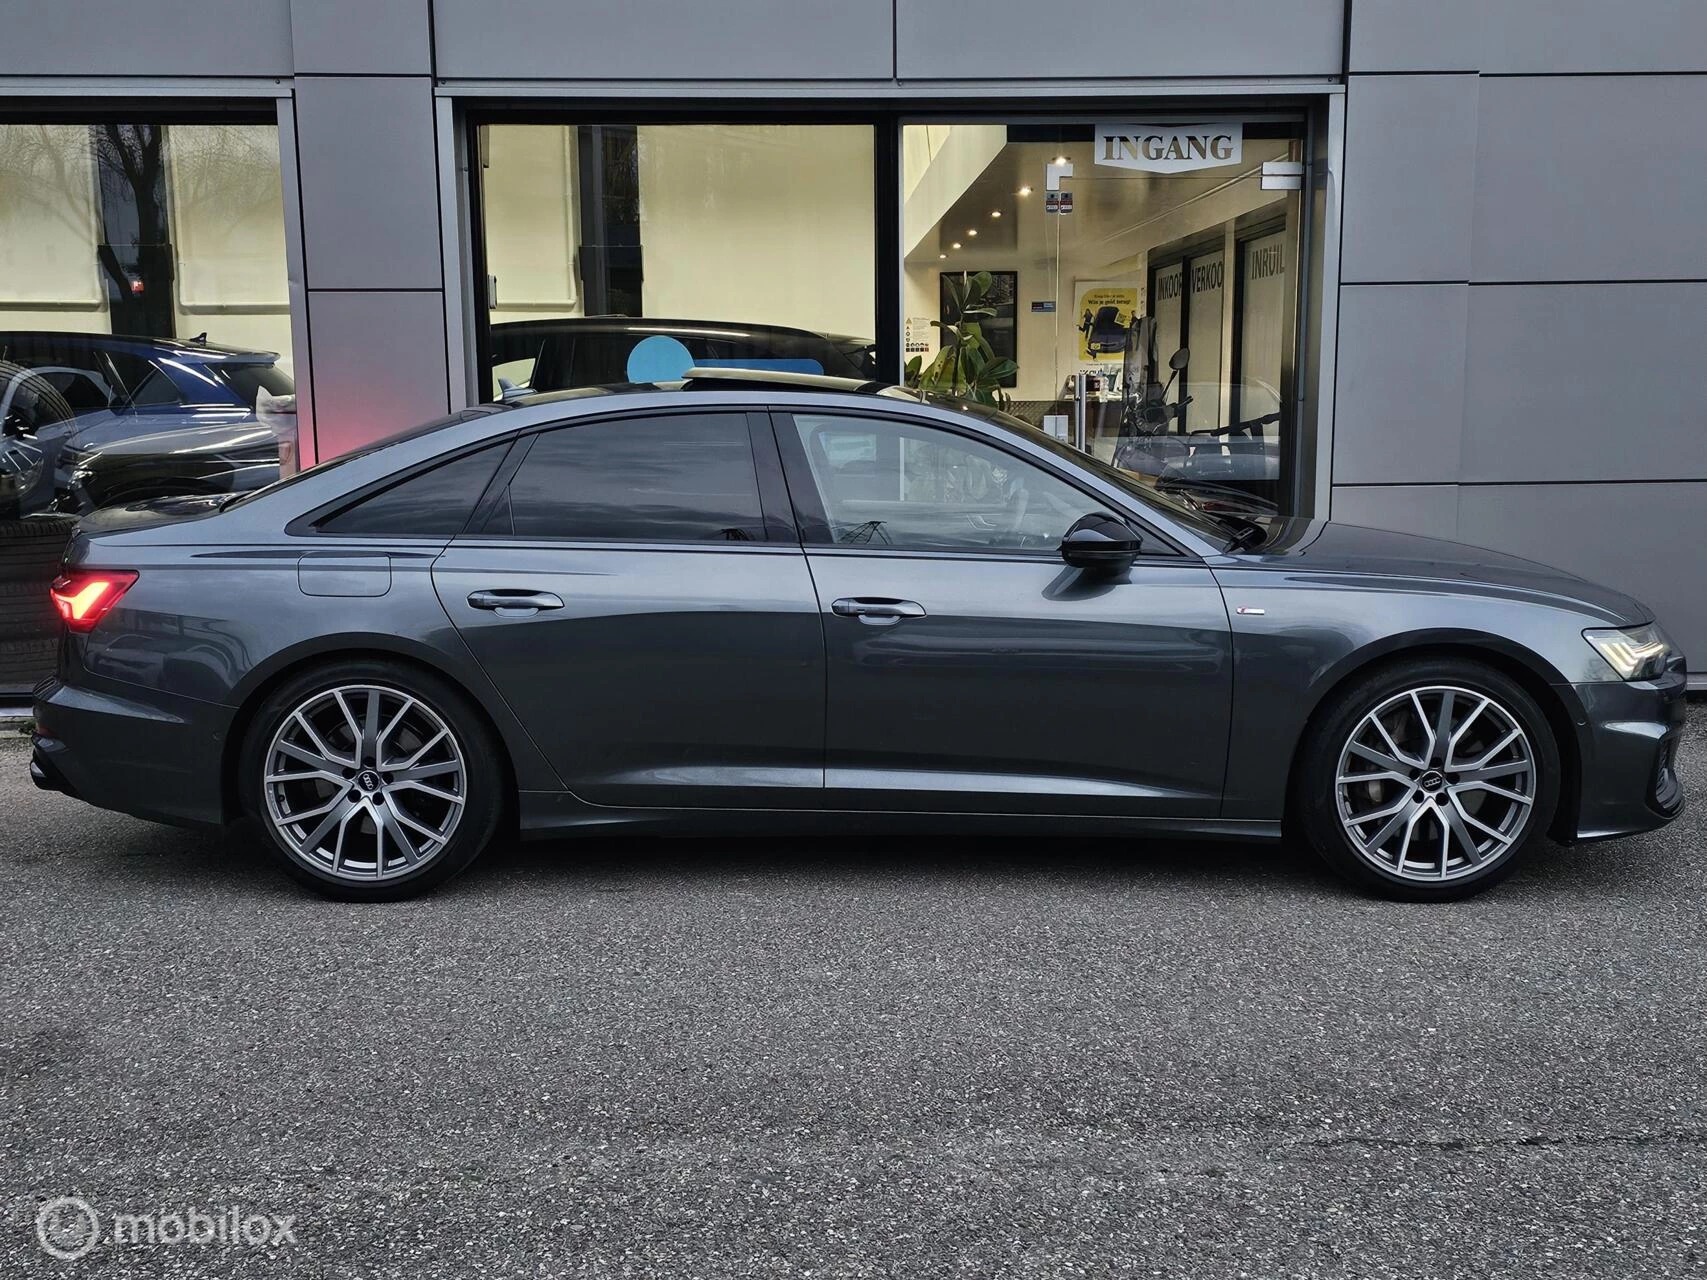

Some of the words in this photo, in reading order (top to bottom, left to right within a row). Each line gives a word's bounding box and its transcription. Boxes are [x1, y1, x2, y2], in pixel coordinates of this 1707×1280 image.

[1103, 135, 1234, 161] INGANG
[1191, 261, 1224, 293] VERKOO
[1252, 244, 1285, 279] INRUIL
